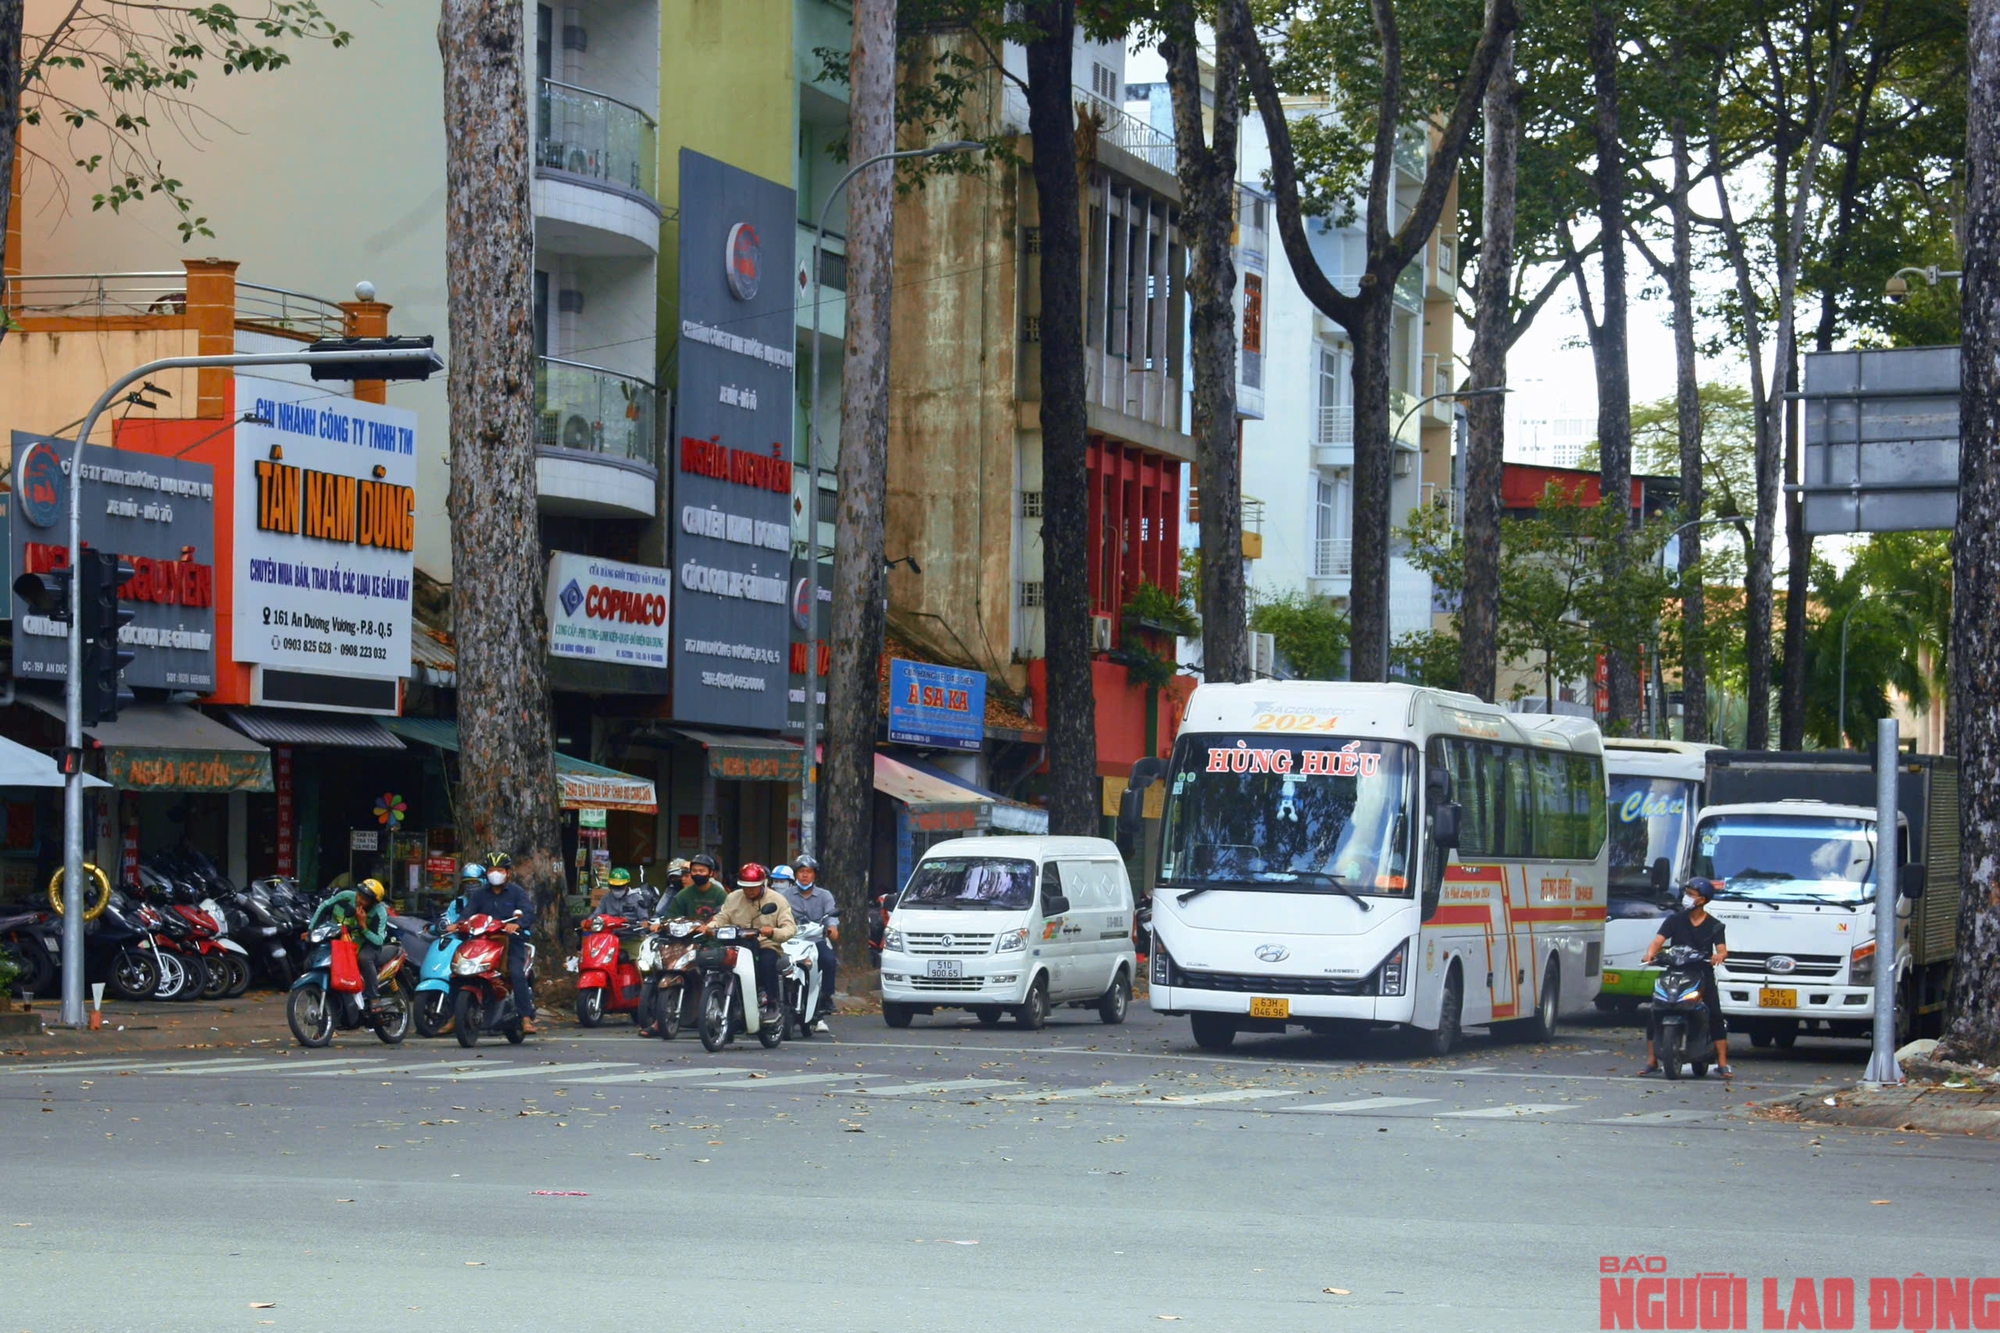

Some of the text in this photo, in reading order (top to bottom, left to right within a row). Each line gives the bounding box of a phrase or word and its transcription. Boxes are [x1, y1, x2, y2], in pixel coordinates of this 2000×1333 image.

[256, 398, 413, 455] CHI NHÁNH CÔNG TY TNHH TM
[255, 444, 416, 553] TÂN NAM DŨNG
[250, 557, 276, 585] CHUYÊN
[278, 563, 293, 588] MUA
[294, 561, 310, 592] BÁN,
[311, 567, 328, 592] TRAO
[343, 568, 355, 595] CÁC
[357, 573, 371, 600] LOẠI
[372, 575, 381, 598] XE
[381, 573, 395, 600] GẮN
[396, 575, 409, 602] MÁY
[585, 585, 666, 627] COPHACO
[274, 610, 288, 626] 161
[292, 612, 303, 624] An
[304, 614, 330, 634] Dương
[332, 617, 356, 636] Vương
[360, 620, 374, 636] P.8
[378, 623, 393, 640] Q.5
[283, 637, 301, 651] 0903
[303, 640, 317, 653] 825
[340, 643, 358, 657] 0908
[359, 645, 374, 659] 223
[373, 647, 387, 660] 032
[908, 683, 969, 713] A SA KA
[1253, 713, 1339, 732] 2024
[1206, 739, 1381, 778] HÙNG HIẾU
[1620, 790, 1684, 823] Châu
[931, 969, 958, 978] 900.65
[937, 961, 953, 969] 51D
[1260, 998, 1279, 1008] 63H
[1763, 998, 1793, 1007] 530.41
[1769, 989, 1787, 998] 51C
[1253, 1006, 1285, 1018] 046.96
